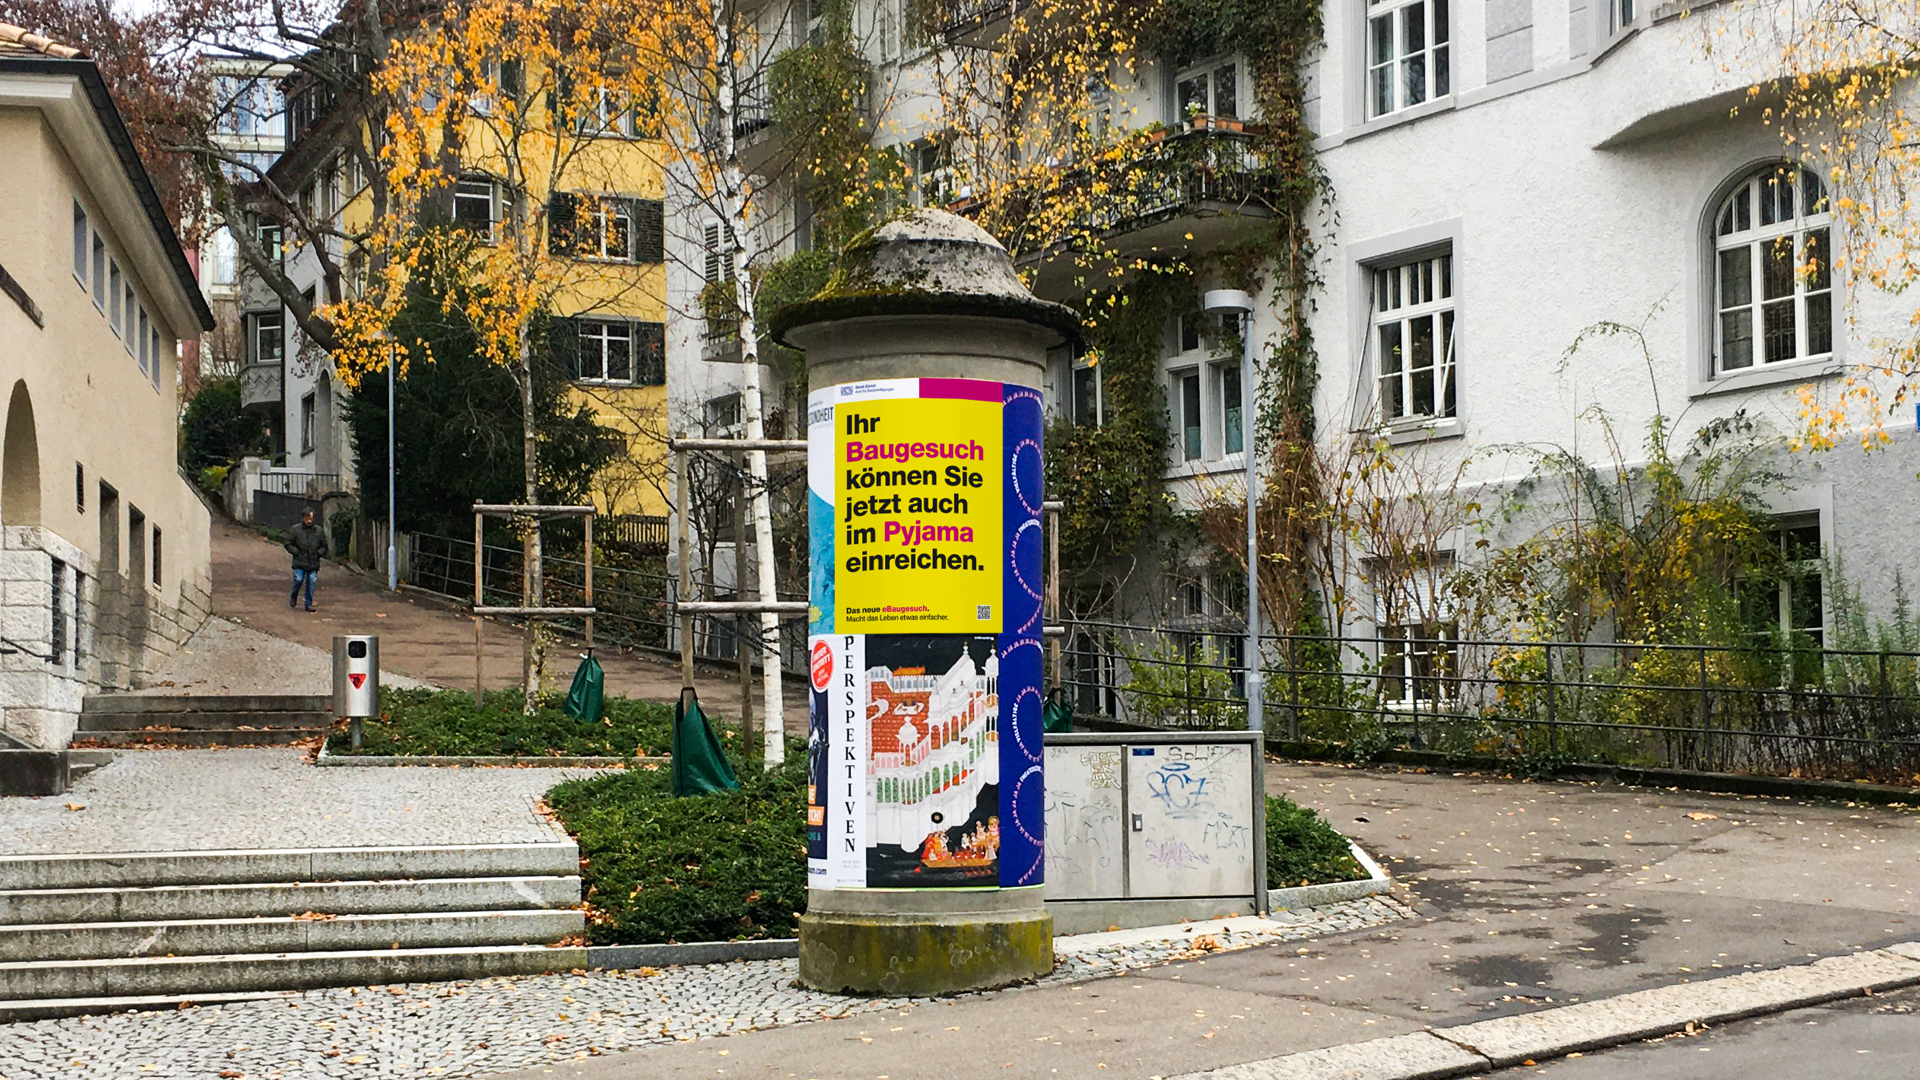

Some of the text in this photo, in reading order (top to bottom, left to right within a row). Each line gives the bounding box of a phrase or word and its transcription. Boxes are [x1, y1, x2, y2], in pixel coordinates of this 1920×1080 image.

[846, 414, 880, 436] Ihr
[846, 440, 984, 463] Baugesuch
[846, 466, 983, 490] können Sie
[845, 494, 968, 523] jetzt auch
[846, 520, 974, 547] im Pyjama
[846, 548, 985, 573] einreichen.
[846, 605, 930, 615] Das neue eBaugesuch.
[846, 615, 866, 623] Macht
[919, 613, 949, 621] einfacher.
[844, 636, 856, 853] PERSPEKTIVEN
